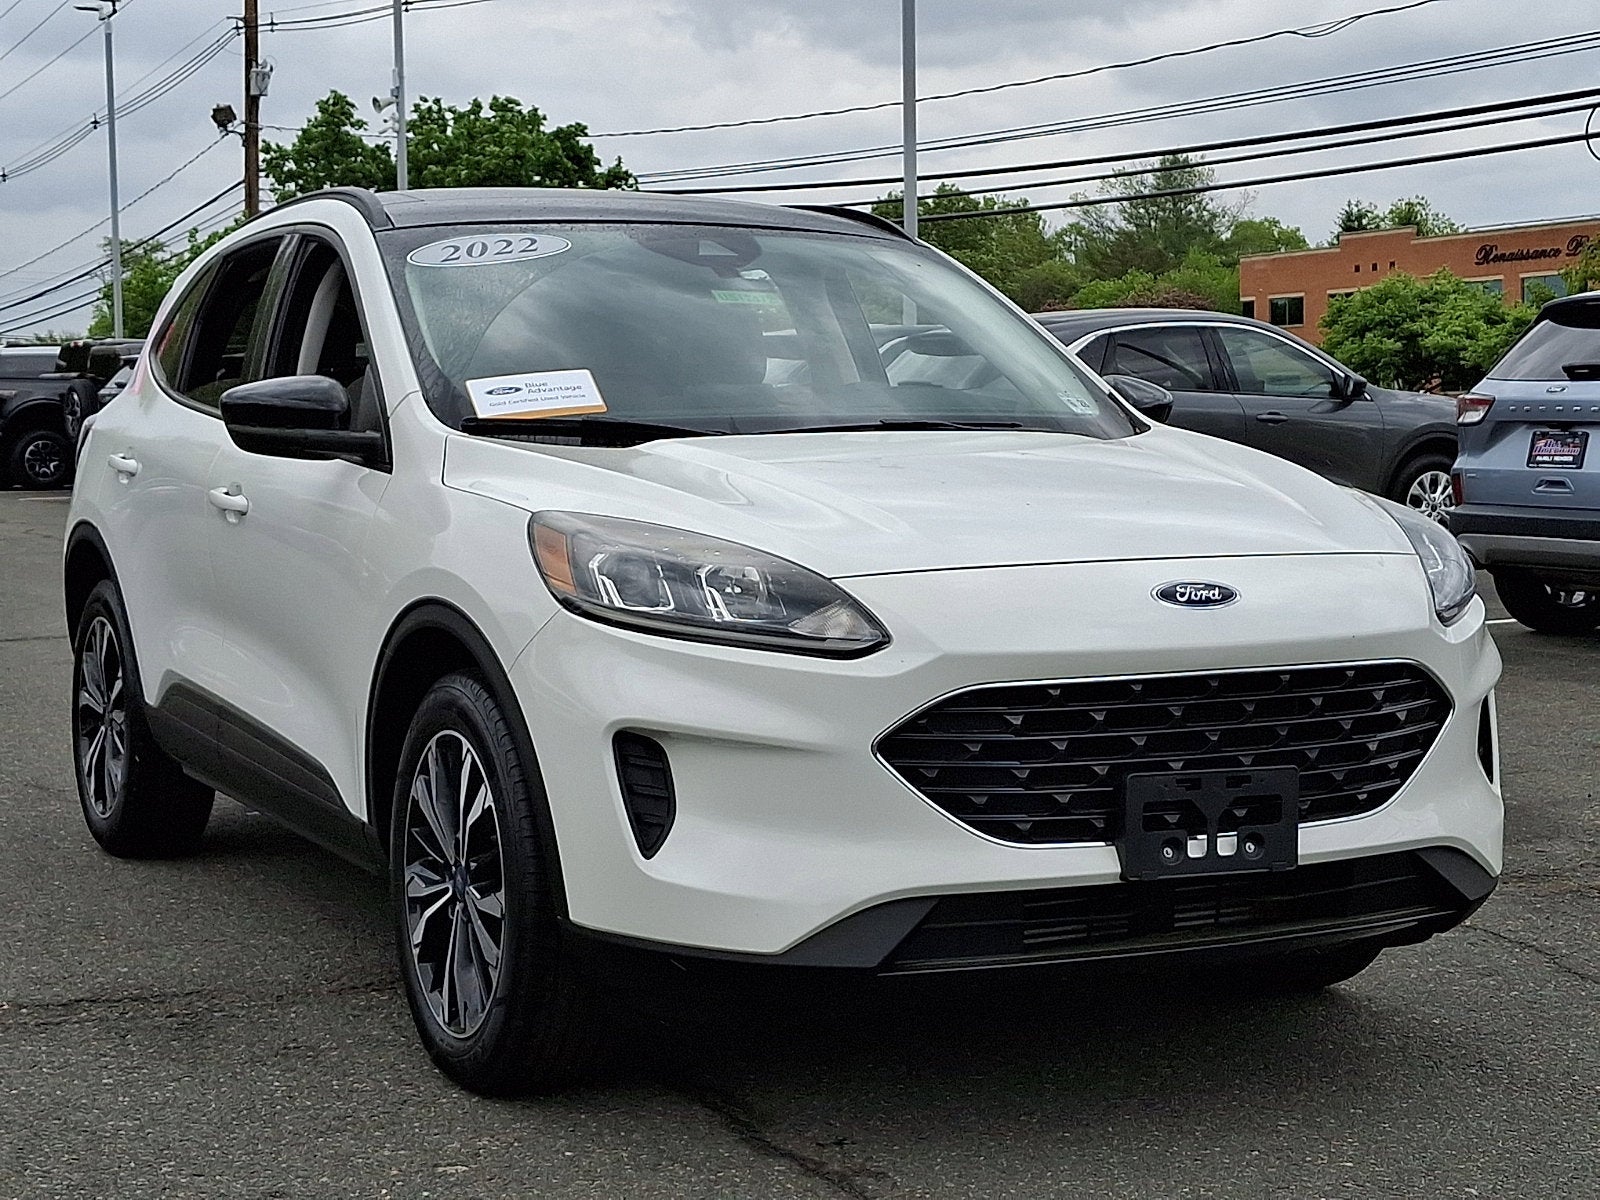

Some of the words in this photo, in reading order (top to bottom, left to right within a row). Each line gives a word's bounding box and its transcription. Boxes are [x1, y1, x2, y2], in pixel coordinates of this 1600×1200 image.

[440, 237, 538, 263] 2022
[1474, 244, 1562, 265] Renaissance
[527, 385, 582, 395] Advantage
[1175, 584, 1222, 602] Ford
